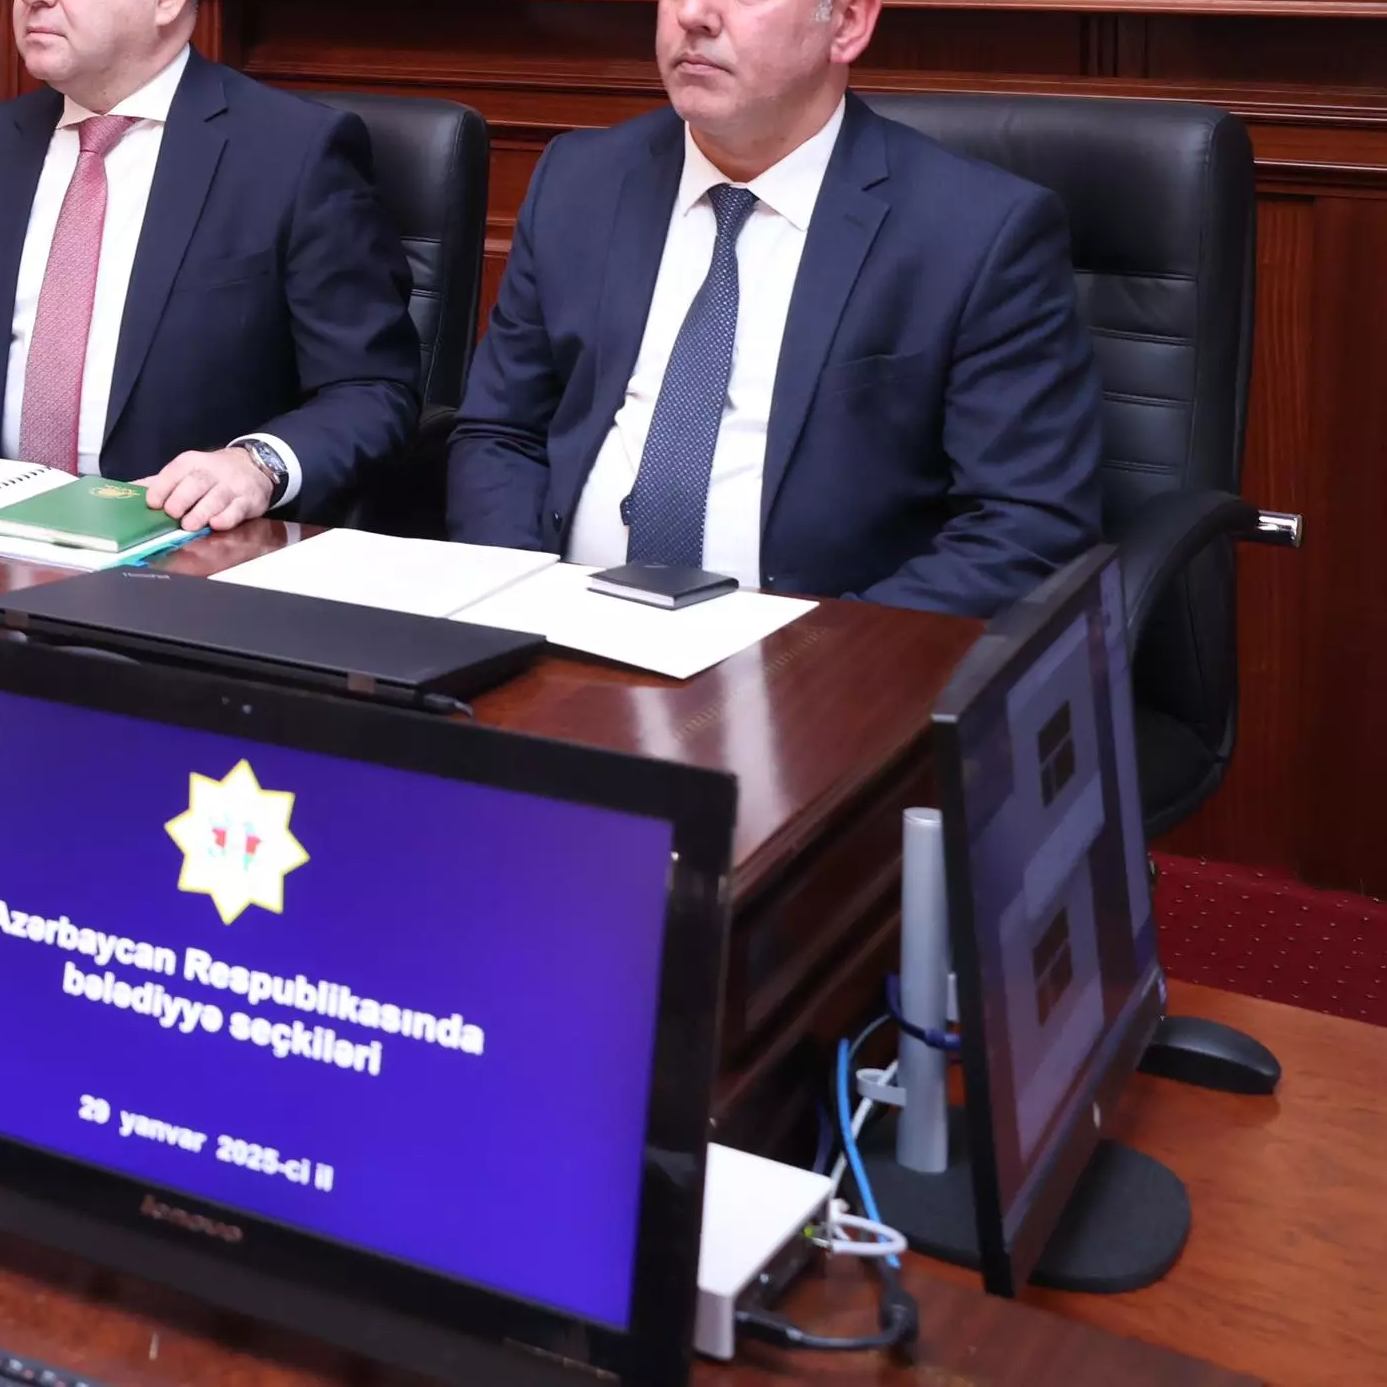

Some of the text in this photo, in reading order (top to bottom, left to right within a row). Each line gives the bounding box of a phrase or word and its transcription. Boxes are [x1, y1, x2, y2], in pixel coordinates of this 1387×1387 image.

[62, 964, 384, 1075] bələdiyyə seçkiləri
[184, 947, 485, 1055] Respublikasında
[79, 1094, 111, 1123] 29
[119, 1108, 206, 1154] yanvar
[216, 1135, 311, 1187] 2025-ci
